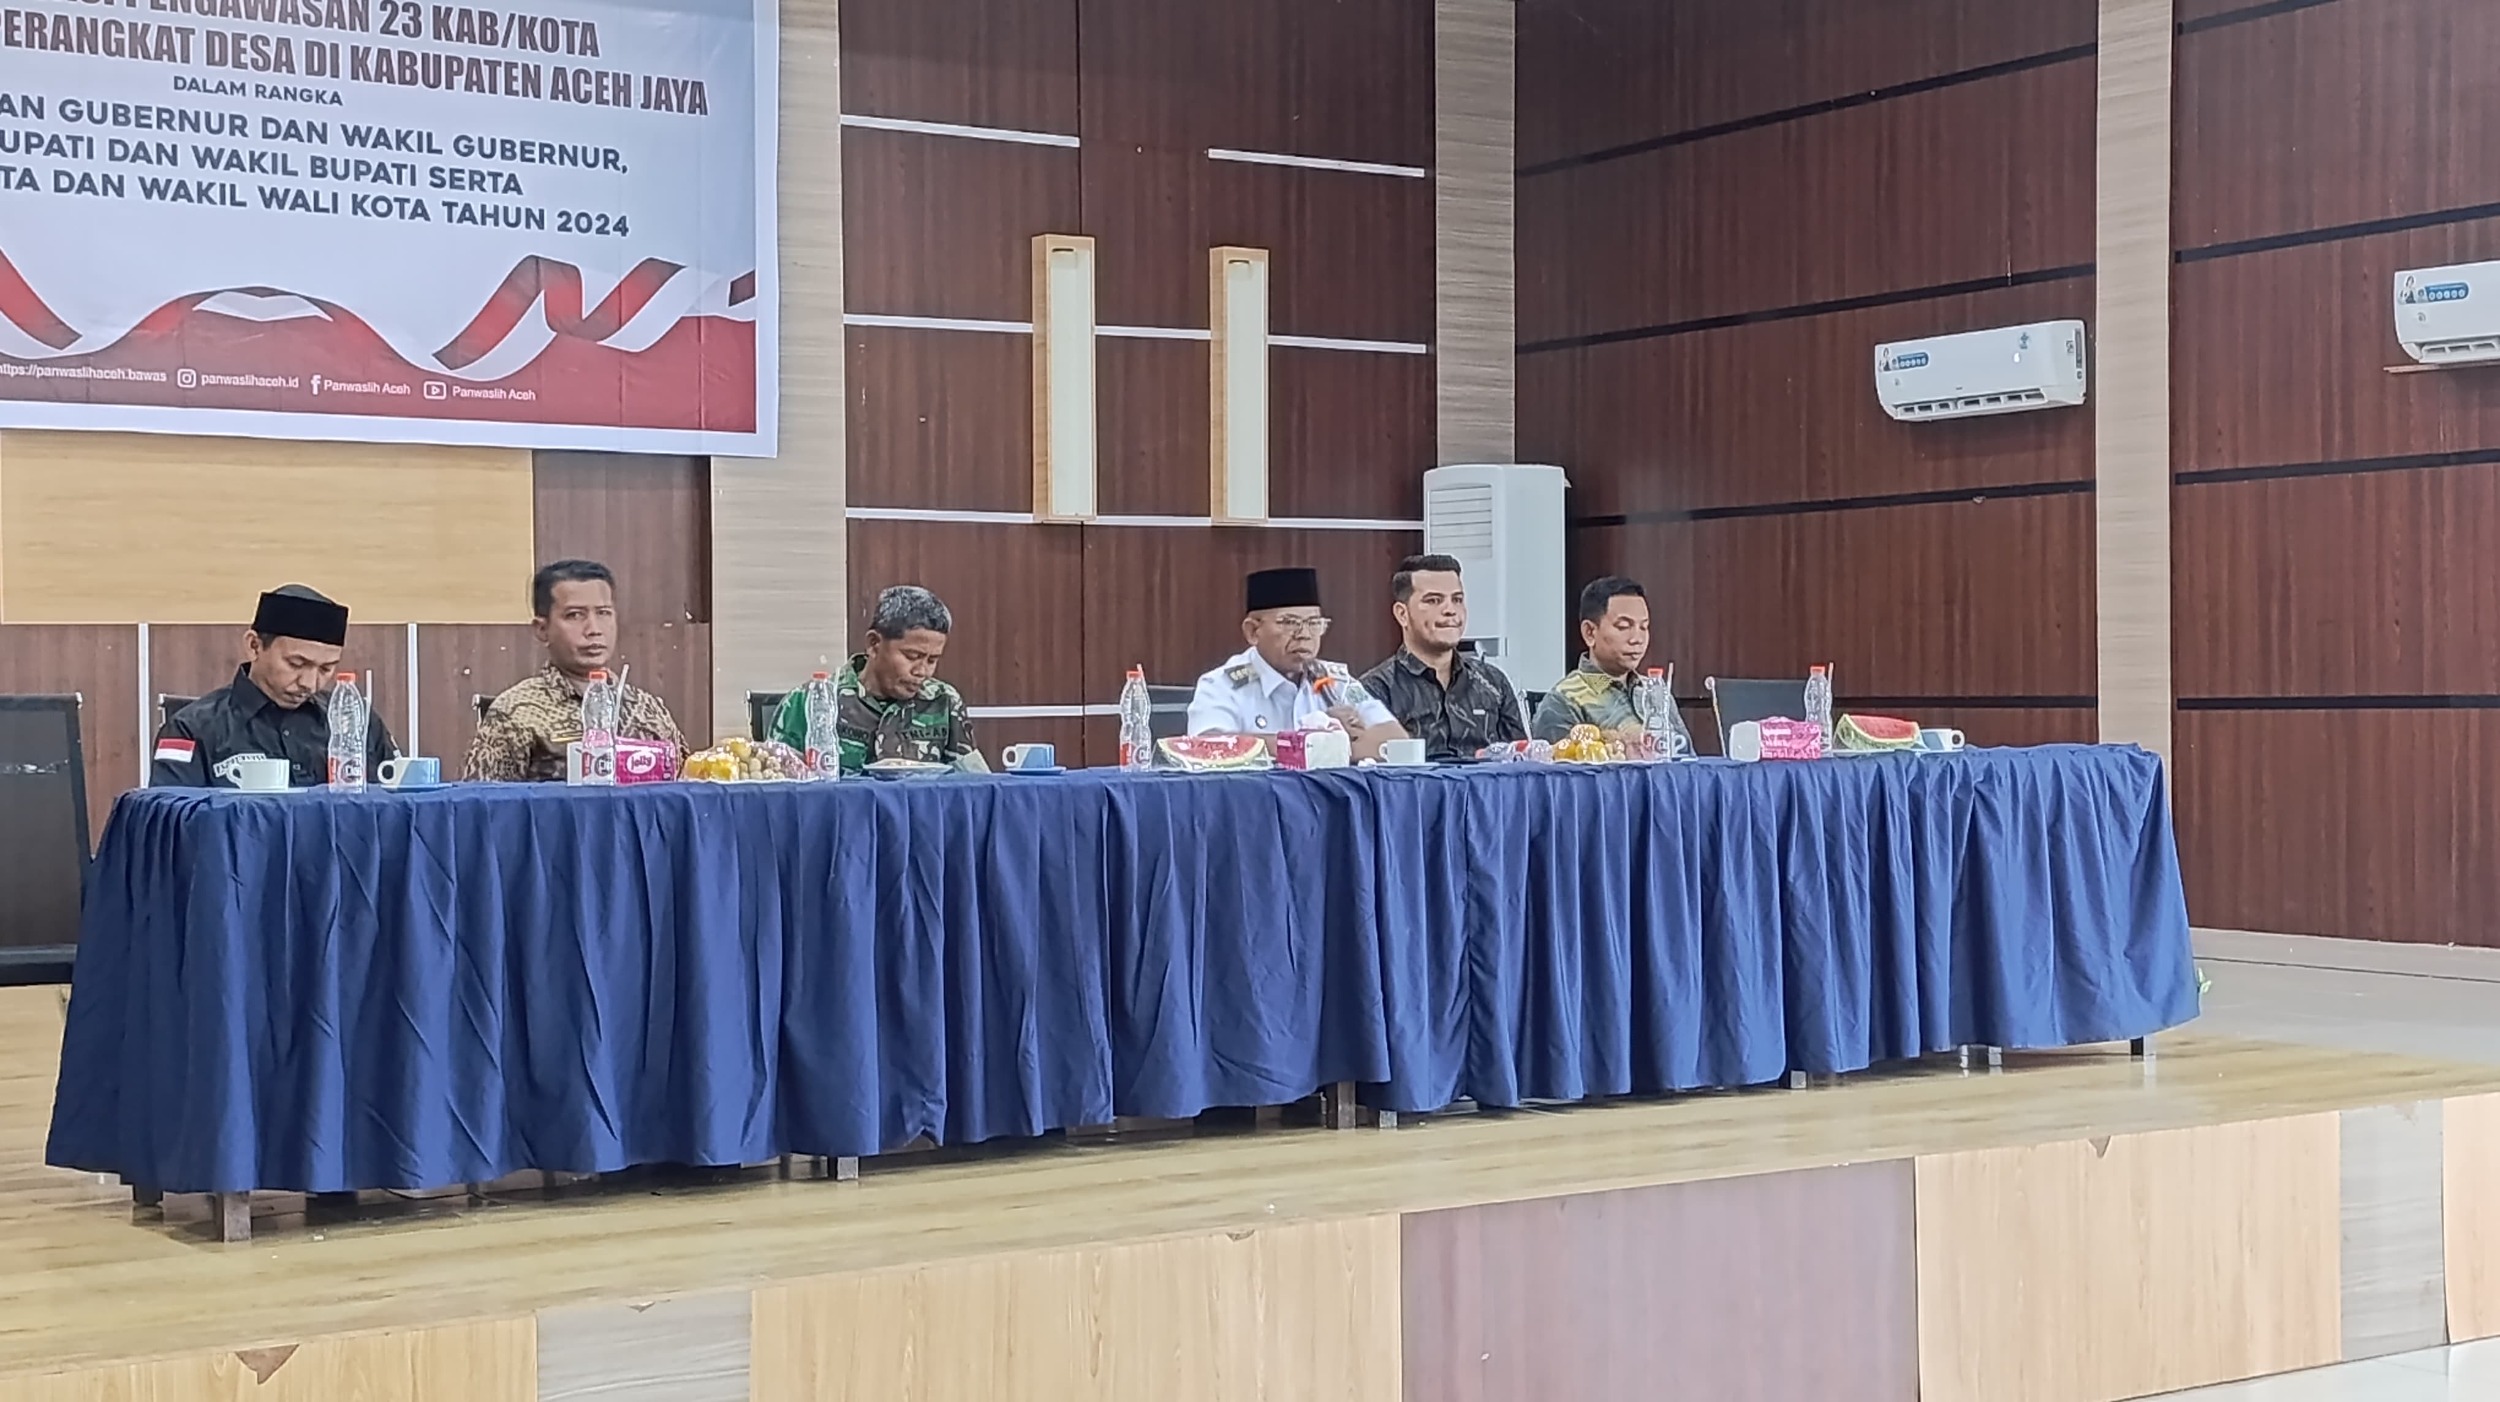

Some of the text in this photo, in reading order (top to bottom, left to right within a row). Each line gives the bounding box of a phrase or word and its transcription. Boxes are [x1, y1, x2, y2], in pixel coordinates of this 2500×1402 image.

[126, 0, 600, 58] AWASAN 23 KAB/KOTA
[0, 8, 708, 115] ERANGKAT DESA DI KABUPATEN ACEH JAYA
[173, 76, 344, 106] DALAM RANGKA
[59, 99, 249, 138] GUBERNUR
[262, 116, 328, 145] DAN
[340, 124, 444, 155] WAKIL
[453, 135, 628, 175] GUBERNUR,
[109, 138, 178, 167] DAN
[191, 145, 299, 177] WAKIL
[310, 155, 417, 187] BUPATI
[429, 166, 523, 195] SERTA
[54, 169, 125, 198] DAN
[138, 176, 248, 207] WAKIL
[257, 185, 339, 214] WALI
[352, 193, 431, 222] KOTA
[442, 201, 545, 230] TAHUN
[557, 210, 629, 237] 2024
[201, 373, 299, 389] panwaslihaceh.id
[324, 380, 380, 394] Panwaslih
[382, 382, 411, 396] Aceh
[452, 385, 507, 399] Panwaslih
[508, 389, 536, 401] Aceh
